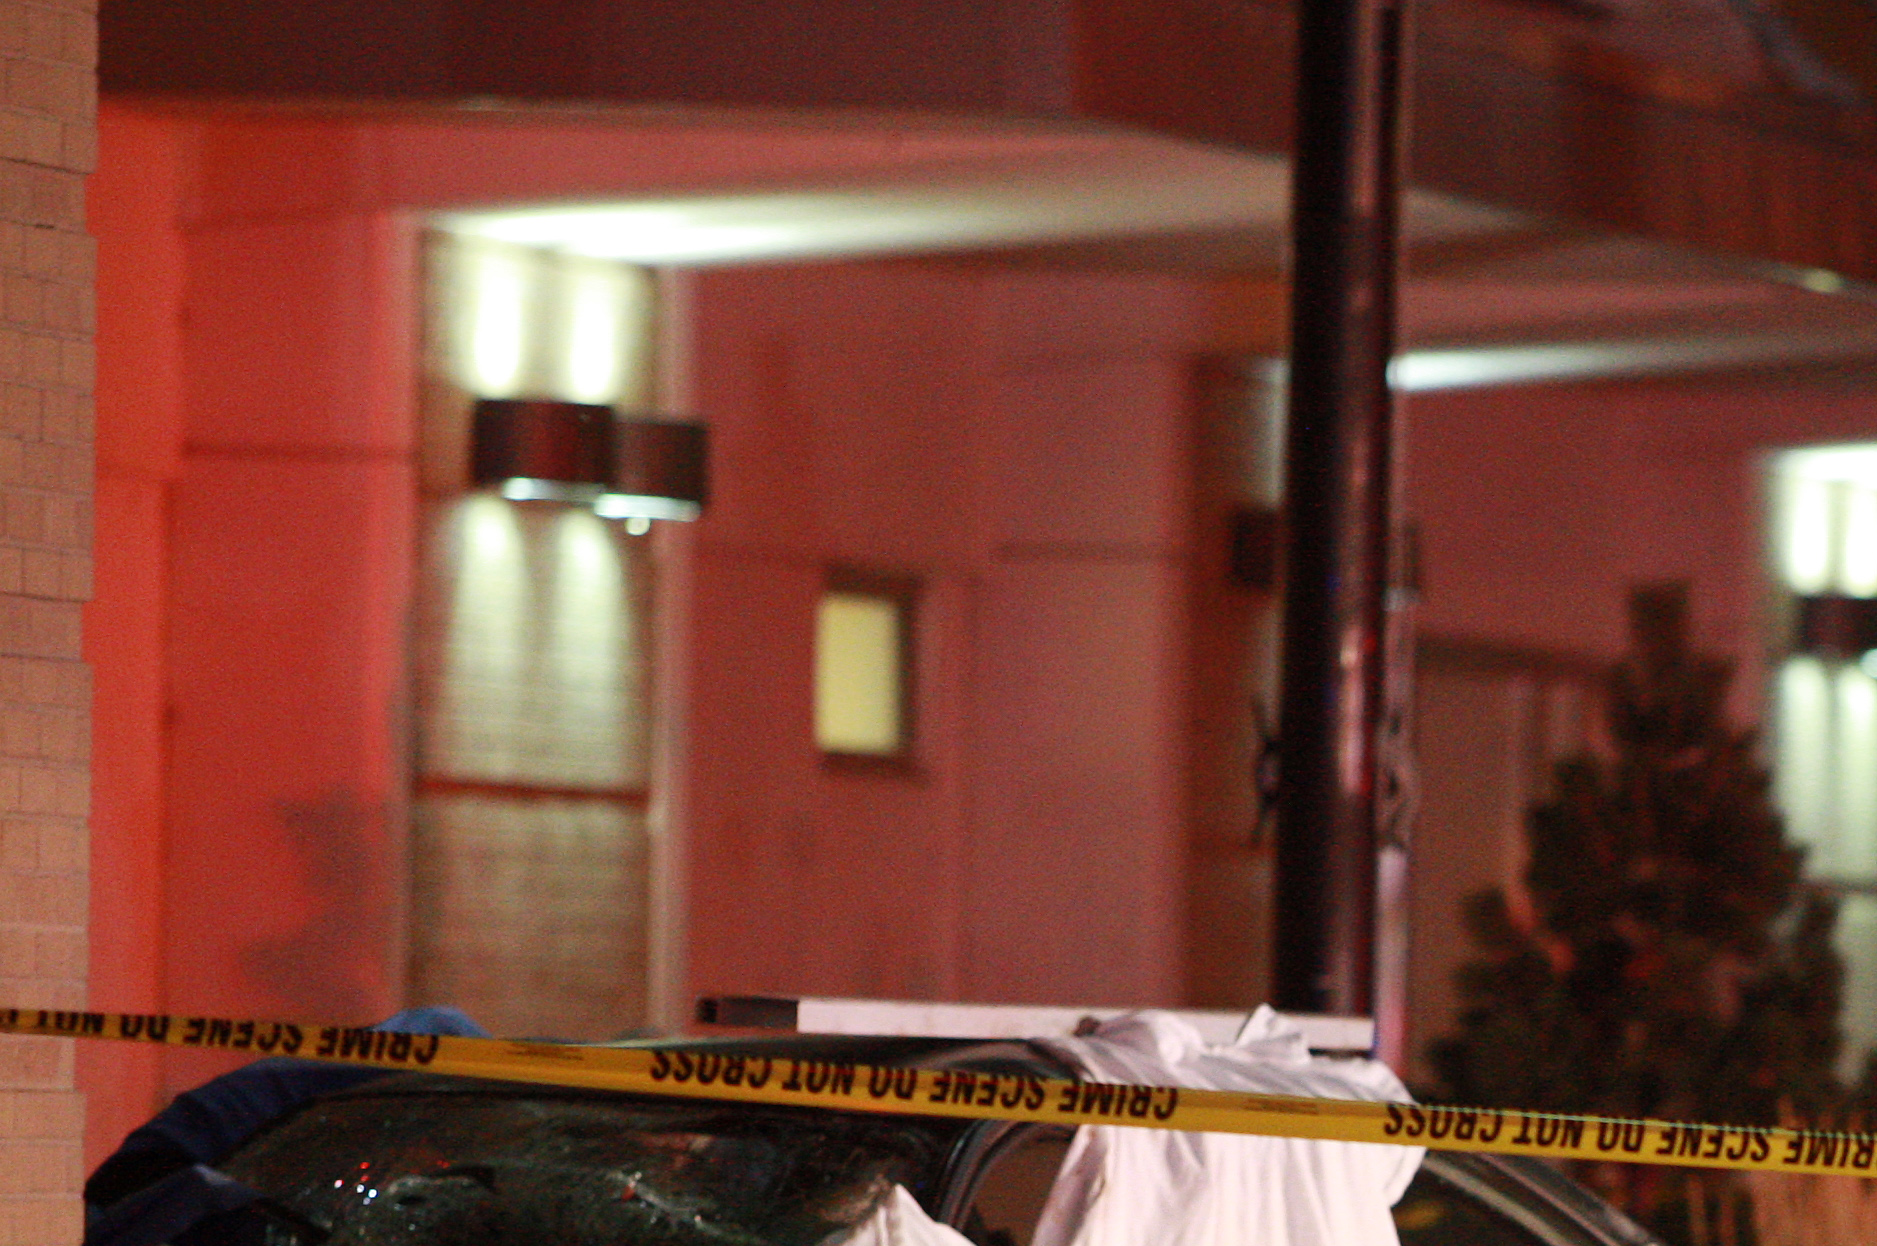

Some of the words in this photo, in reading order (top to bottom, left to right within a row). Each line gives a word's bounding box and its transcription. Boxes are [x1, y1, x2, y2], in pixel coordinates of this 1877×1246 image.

[183, 1018, 302, 1056] SCENE
[317, 1027, 439, 1065] CRIME
[650, 1049, 771, 1089] CROSS
[782, 1057, 856, 1096] NOT
[869, 1063, 918, 1101] DO
[928, 1069, 1046, 1111] SCENE
[1059, 1079, 1178, 1120] CRIME
[1384, 1103, 1505, 1143] CROSS
[1513, 1111, 1585, 1149] NOT
[1597, 1116, 1644, 1152] DO
[1657, 1121, 1772, 1163] SCENE
